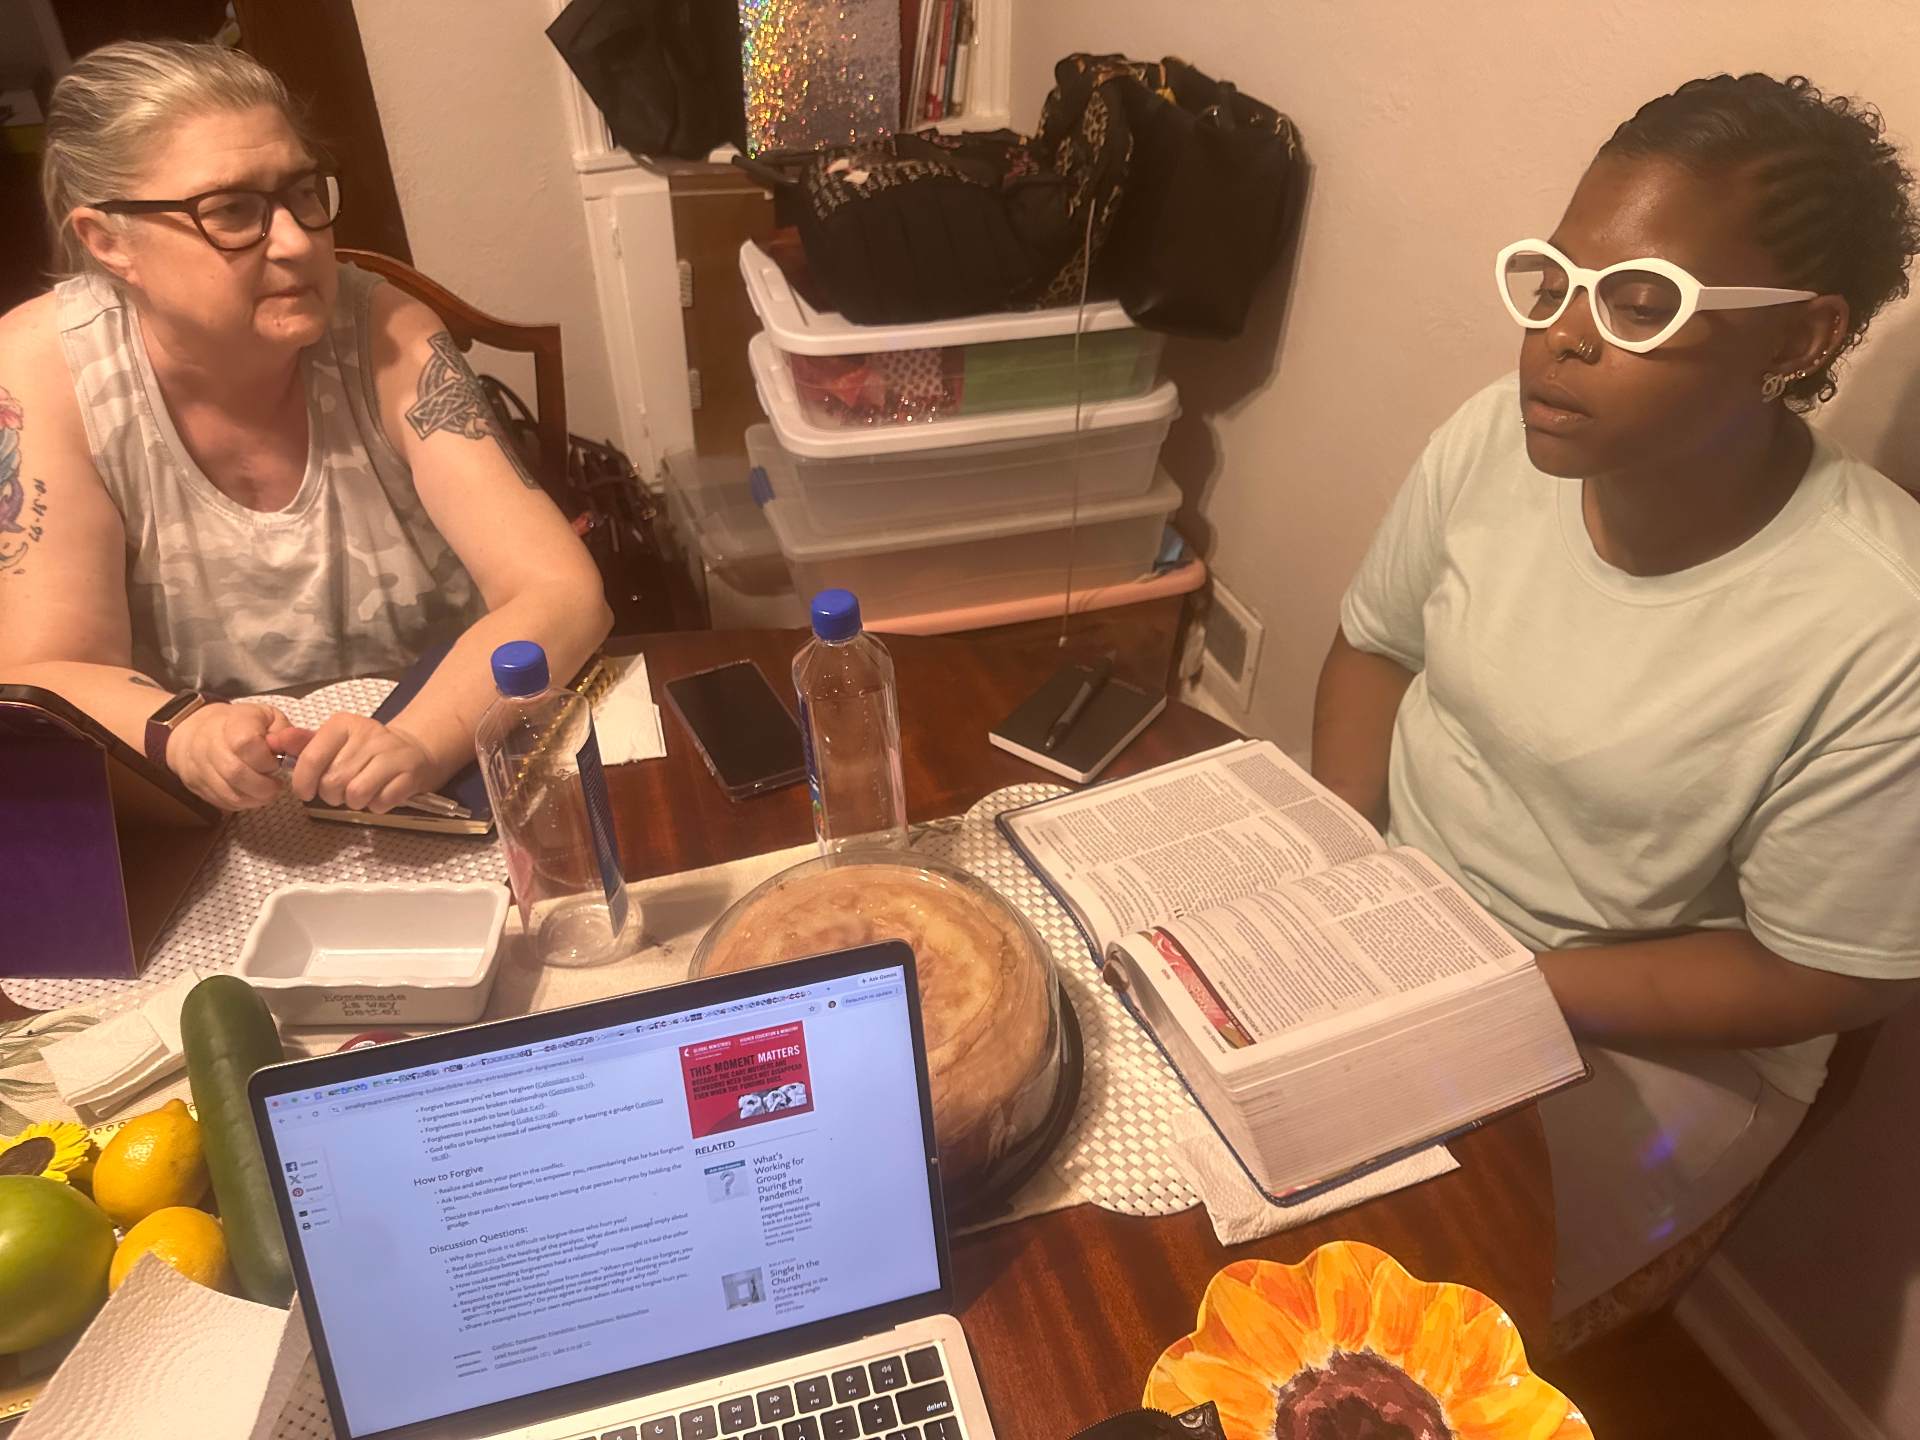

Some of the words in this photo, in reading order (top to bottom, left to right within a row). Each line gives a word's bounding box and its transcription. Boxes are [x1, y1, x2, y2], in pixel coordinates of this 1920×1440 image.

[879, 971, 897, 979] Gemini
[323, 993, 406, 1003] homemade
[844, 994, 868, 1004] Relaunch
[1219, 980, 1242, 1010] ENCOUNTER
[342, 1001, 361, 1010] is
[366, 1001, 396, 1011] way
[344, 1008, 402, 1017] better
[1241, 1009, 1261, 1034] PERSONAL
[689, 1064, 712, 1077] THIS
[713, 1054, 754, 1072] MOMENT
[757, 1044, 800, 1062] MATTERS
[420, 1103, 444, 1113] Forgive
[443, 1097, 469, 1107] because
[470, 1092, 492, 1103] you've
[492, 1089, 508, 1097] been
[508, 1083, 534, 1094] forgiven
[422, 1110, 459, 1123] Forgiveness
[459, 1105, 485, 1114] restores
[485, 1099, 507, 1109] broken
[508, 1091, 548, 1105] relationships
[548, 1085, 575, 1096] (Genesis
[424, 1120, 461, 1133] Forgiveness
[472, 1114, 488, 1124] path
[509, 1105, 529, 1116] (Luke
[429, 1144, 443, 1153] God
[443, 1142, 457, 1150] tells
[473, 1134, 496, 1144] forgive
[496, 1128, 519, 1138] instead
[527, 1122, 551, 1132] seeking
[551, 1117, 576, 1127] revenge
[584, 1109, 608, 1120] bearing
[612, 1103, 634, 1114] grudge
[634, 1097, 663, 1109] (Leviticus
[427, 1130, 464, 1144] Forgiveness
[464, 1124, 492, 1136] precedes
[492, 1119, 516, 1130] healing
[515, 1115, 534, 1125] (Luke
[694, 1139, 735, 1155] RELATED
[752, 1151, 782, 1165] What's
[754, 1160, 791, 1175] Working
[791, 1156, 804, 1166] for
[413, 1175, 436, 1186] How
[437, 1173, 448, 1181] to
[449, 1165, 483, 1179] Forgive
[438, 1184, 461, 1194] Realize
[461, 1181, 474, 1189] and
[474, 1177, 492, 1186] admit
[493, 1174, 508, 1183] your
[508, 1171, 521, 1180] part
[440, 1196, 452, 1204] Ask
[482, 1184, 509, 1194] ultimate
[542, 1170, 571, 1182] empower
[586, 1157, 626, 1172] remembering
[659, 1144, 684, 1155] forgiven
[755, 1171, 786, 1185] Groups
[757, 1180, 787, 1194] During
[788, 1176, 802, 1186] the
[758, 1185, 803, 1203] Pandemic?
[428, 1237, 477, 1254] Discussion
[478, 1225, 528, 1244] Questions:
[770, 1264, 795, 1278] Single
[805, 1259, 819, 1268] the
[771, 1272, 800, 1286] Church
[926, 1400, 948, 1413] delete
